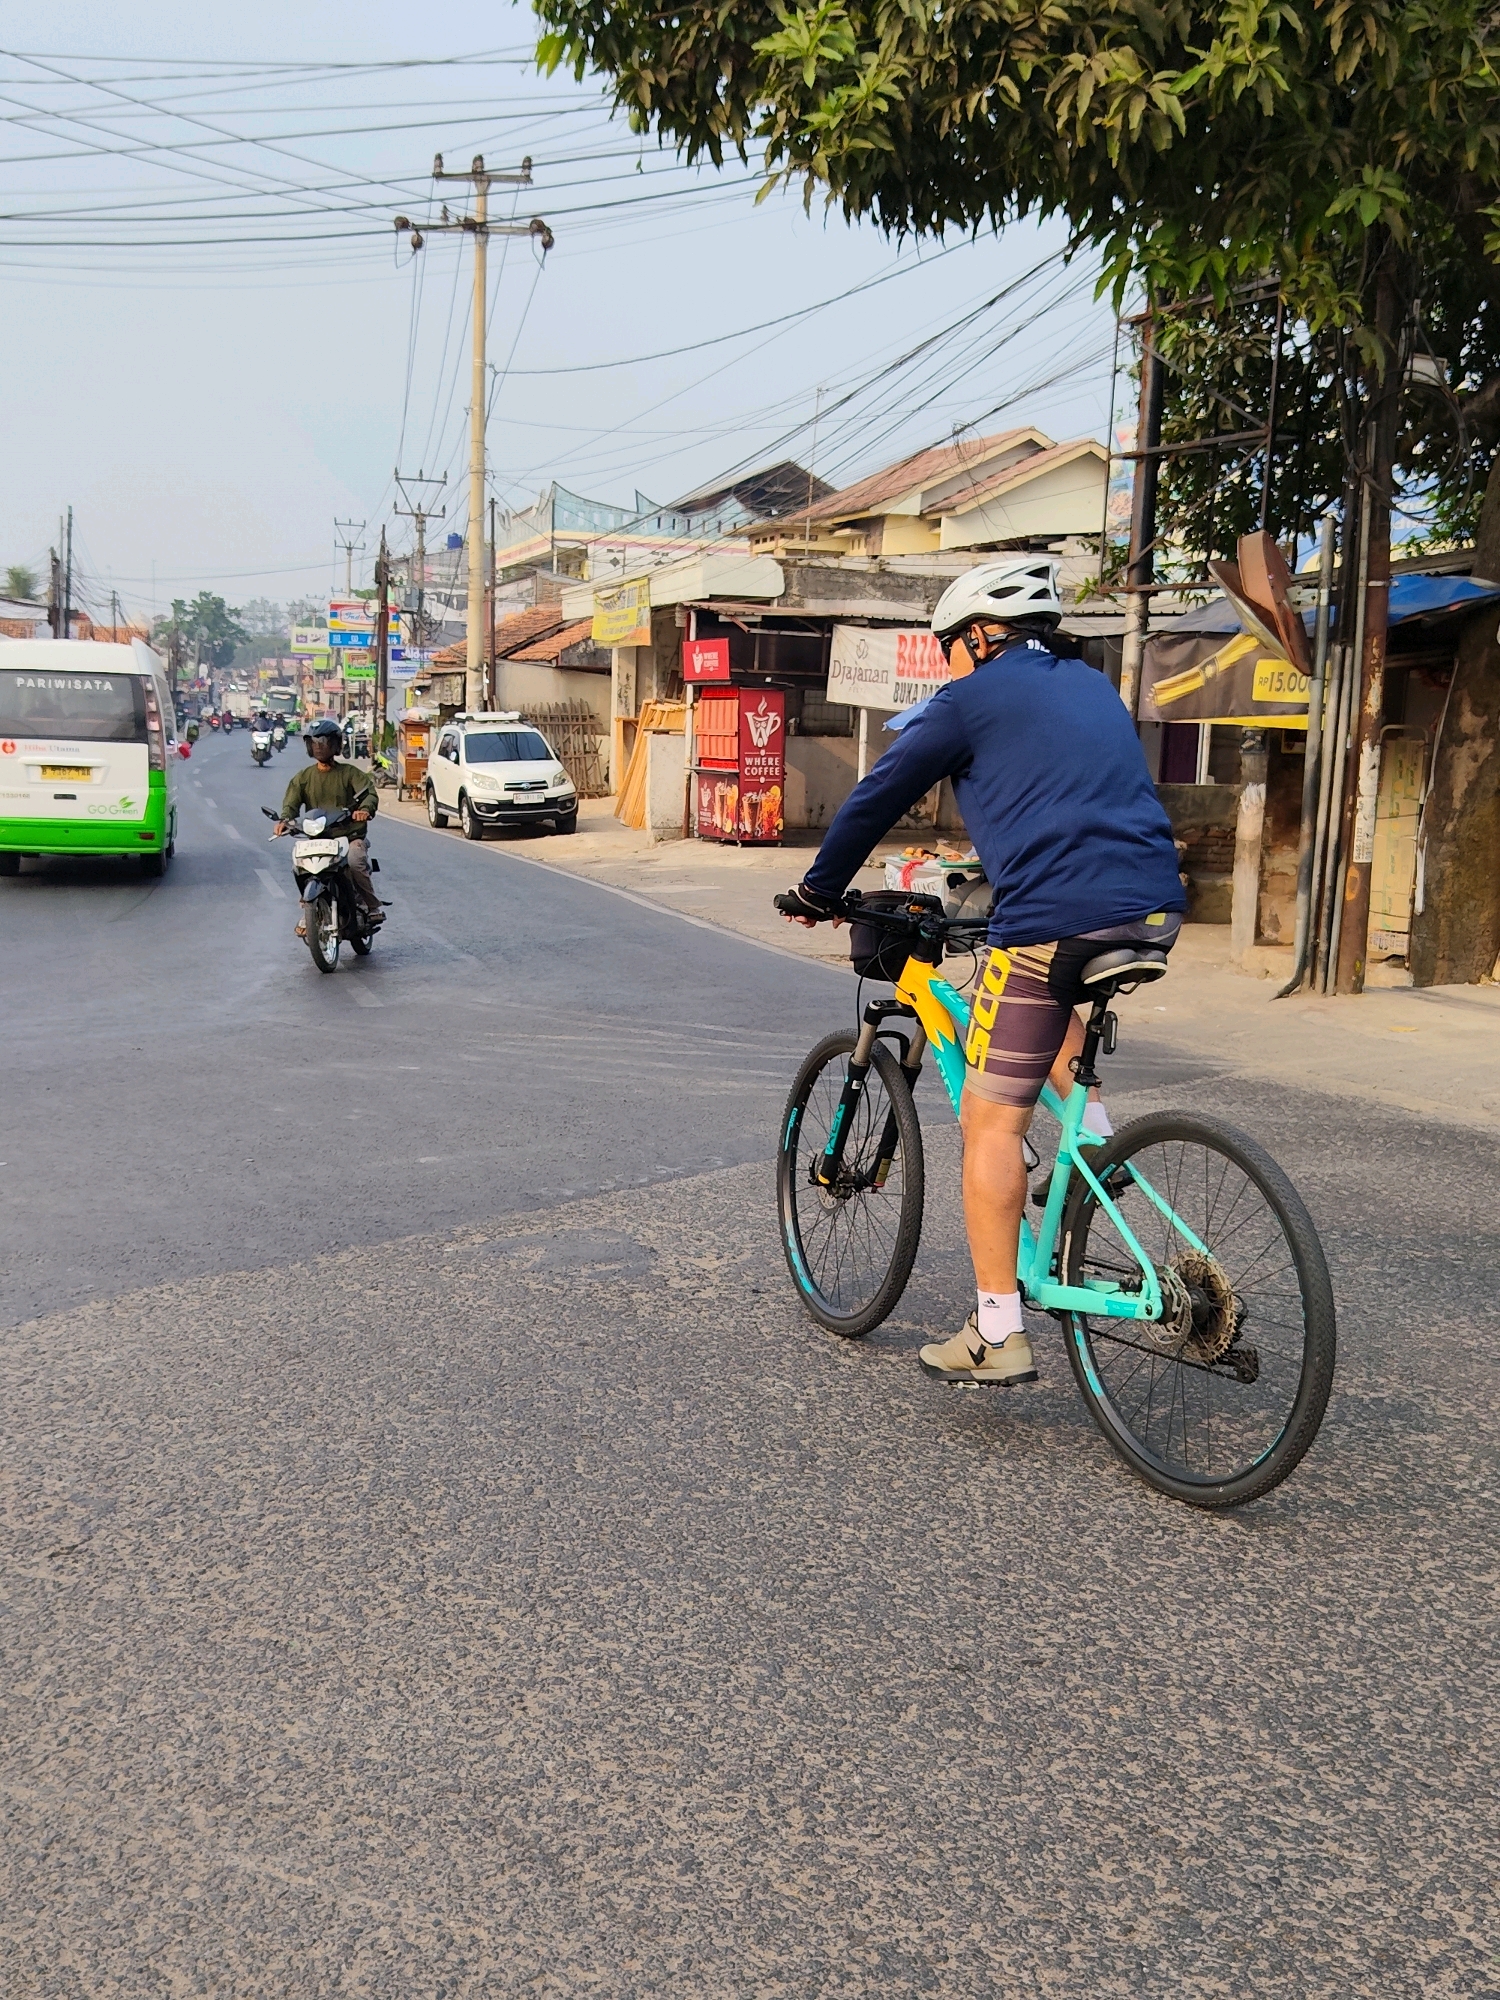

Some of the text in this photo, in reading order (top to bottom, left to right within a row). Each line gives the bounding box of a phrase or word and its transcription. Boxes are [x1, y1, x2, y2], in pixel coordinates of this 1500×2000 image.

[831, 660, 889, 685] Djajanan
[16, 677, 114, 691] PARIWISATA
[893, 682, 919, 704] BUKA
[745, 757, 780, 766] WHERE
[745, 766, 780, 776] COFFEE
[966, 947, 1018, 1075] SCO
